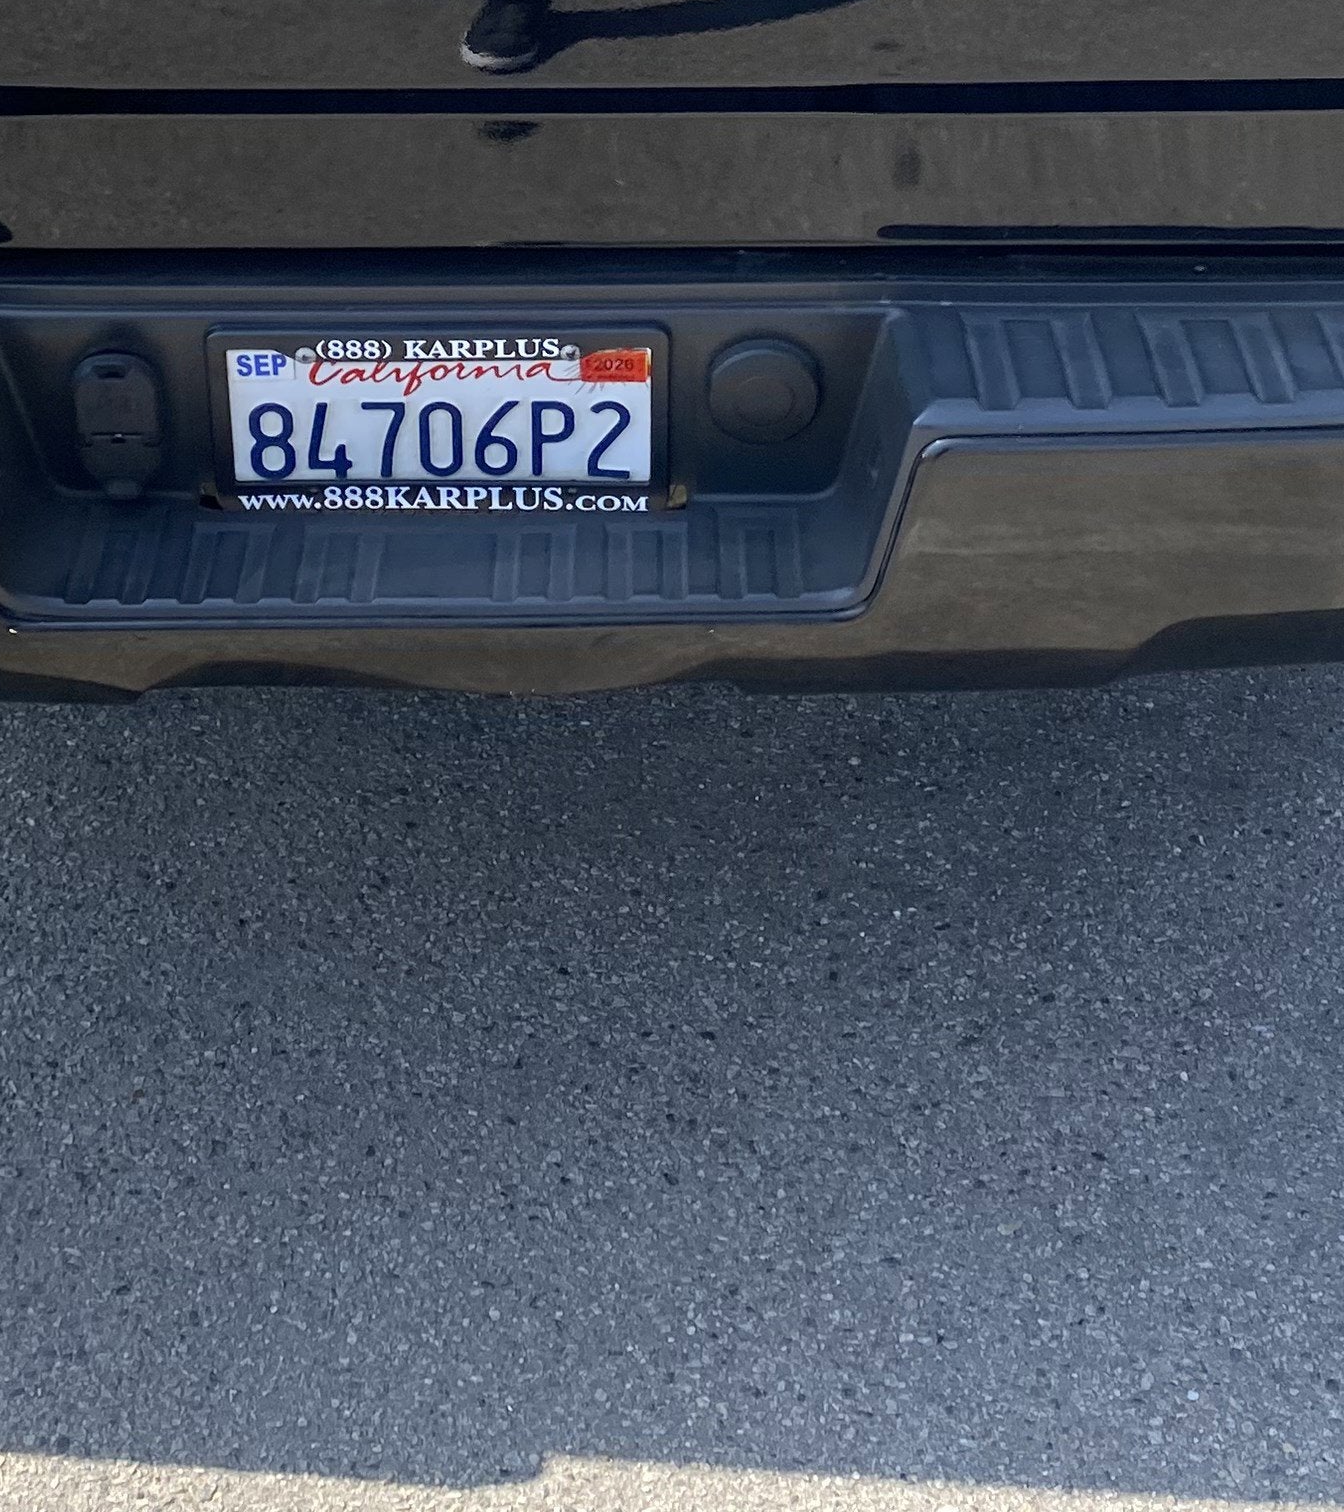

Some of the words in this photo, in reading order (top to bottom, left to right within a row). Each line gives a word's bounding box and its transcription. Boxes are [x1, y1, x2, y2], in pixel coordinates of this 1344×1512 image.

[316, 339, 392, 359] (888)
[403, 338, 561, 359] KARPLUS
[236, 353, 287, 377] SEP
[309, 358, 581, 396] California
[248, 400, 632, 480] 84706P2
